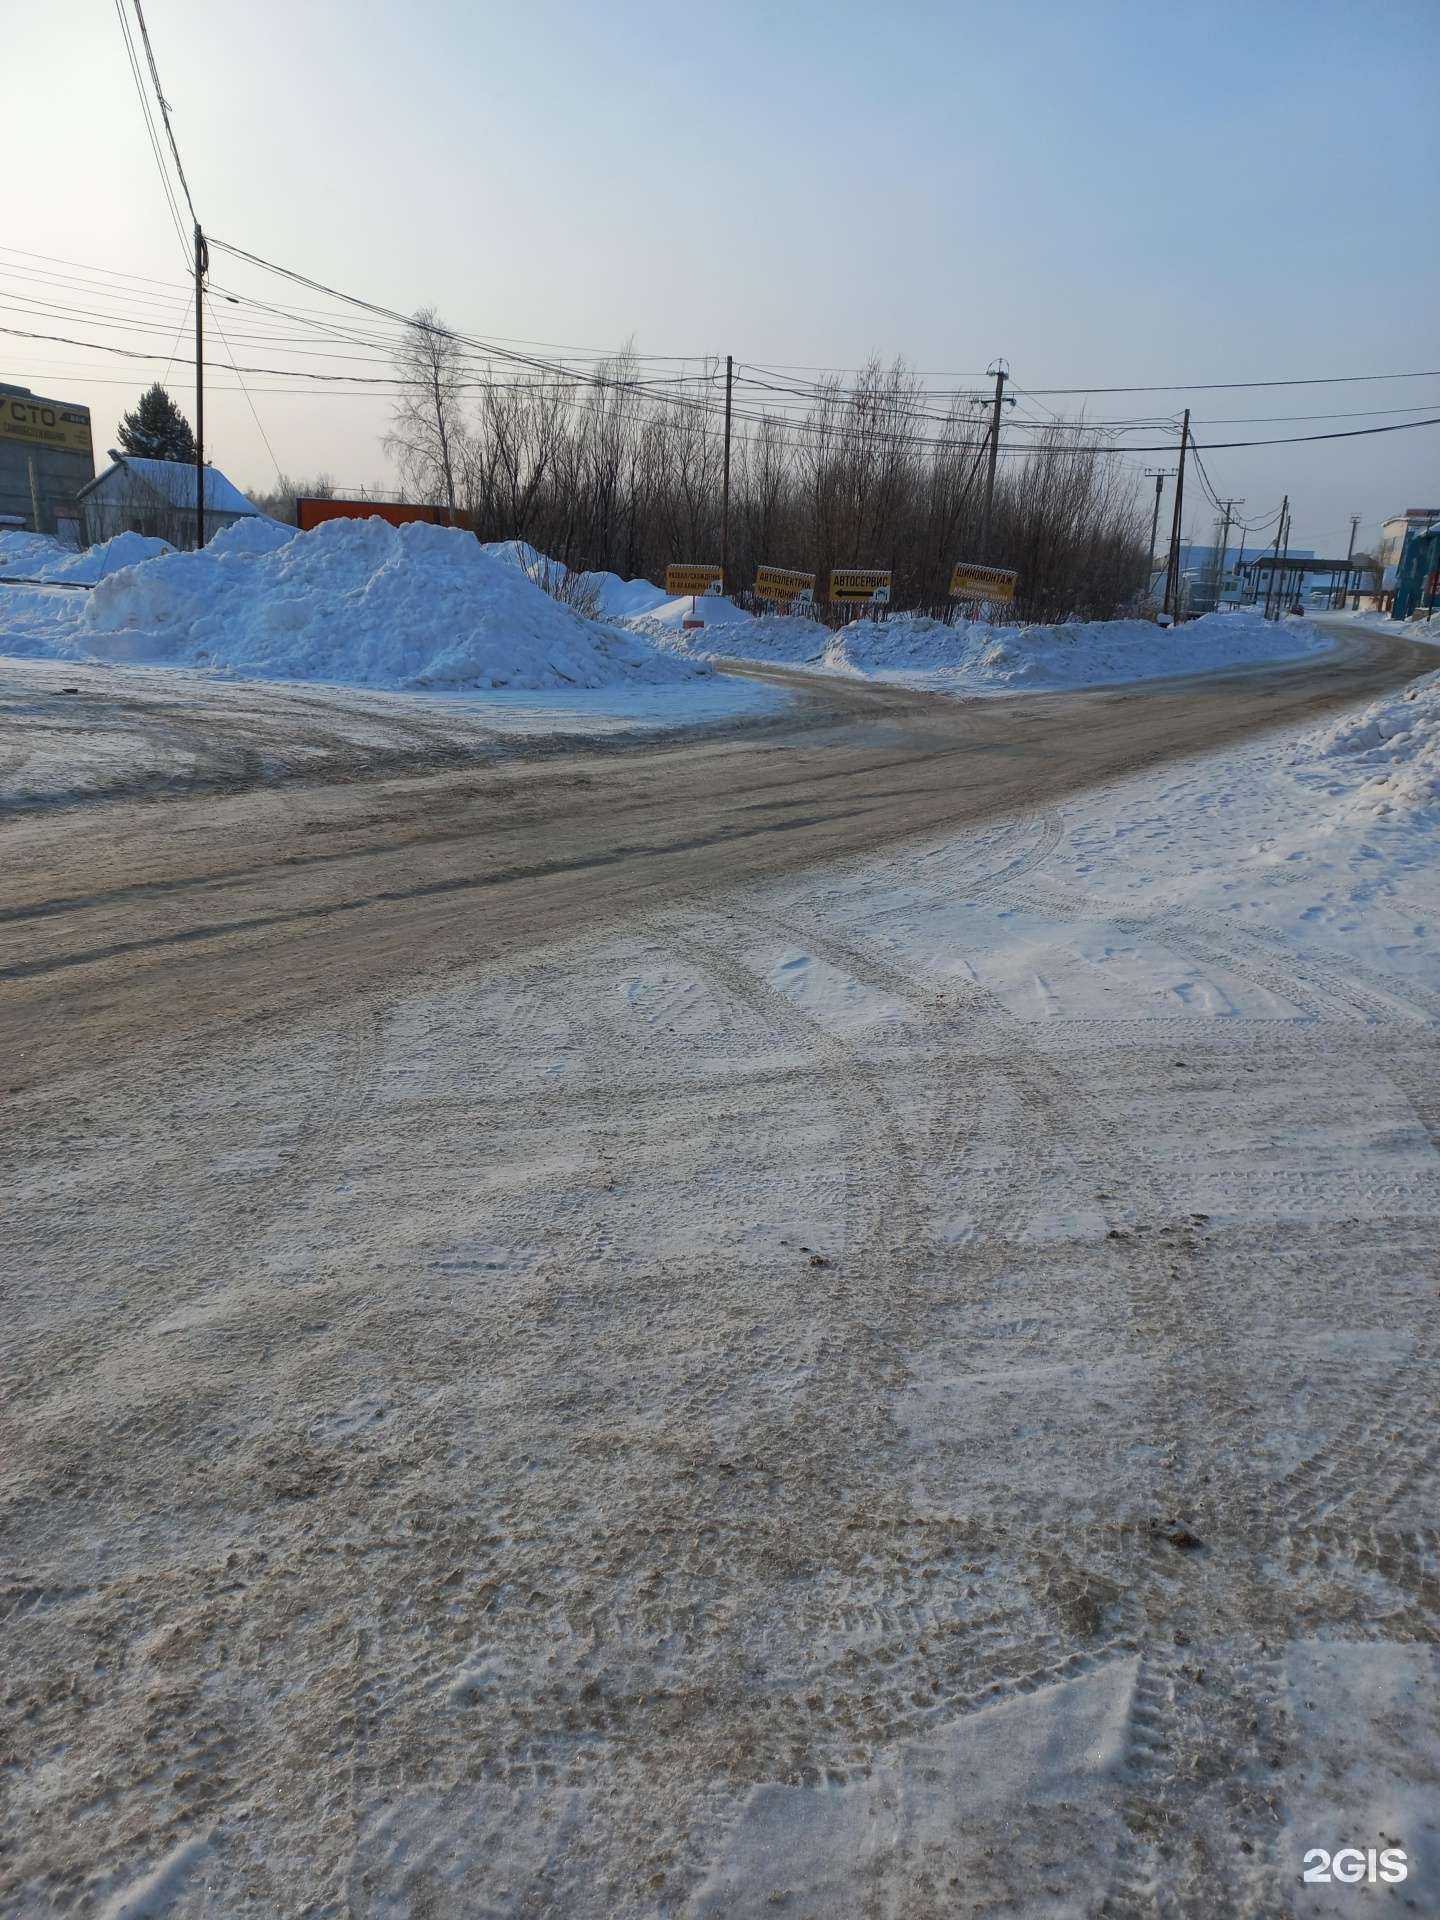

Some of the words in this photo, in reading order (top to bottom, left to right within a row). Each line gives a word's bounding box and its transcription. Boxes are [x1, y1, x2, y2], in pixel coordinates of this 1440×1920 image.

[11, 402, 56, 428] СТО
[759, 571, 812, 589] АВТОЭЛЕКТРИК
[833, 575, 889, 587] АВТОСЕРВИС
[956, 567, 1013, 585] ШИНОМОНТАЖ
